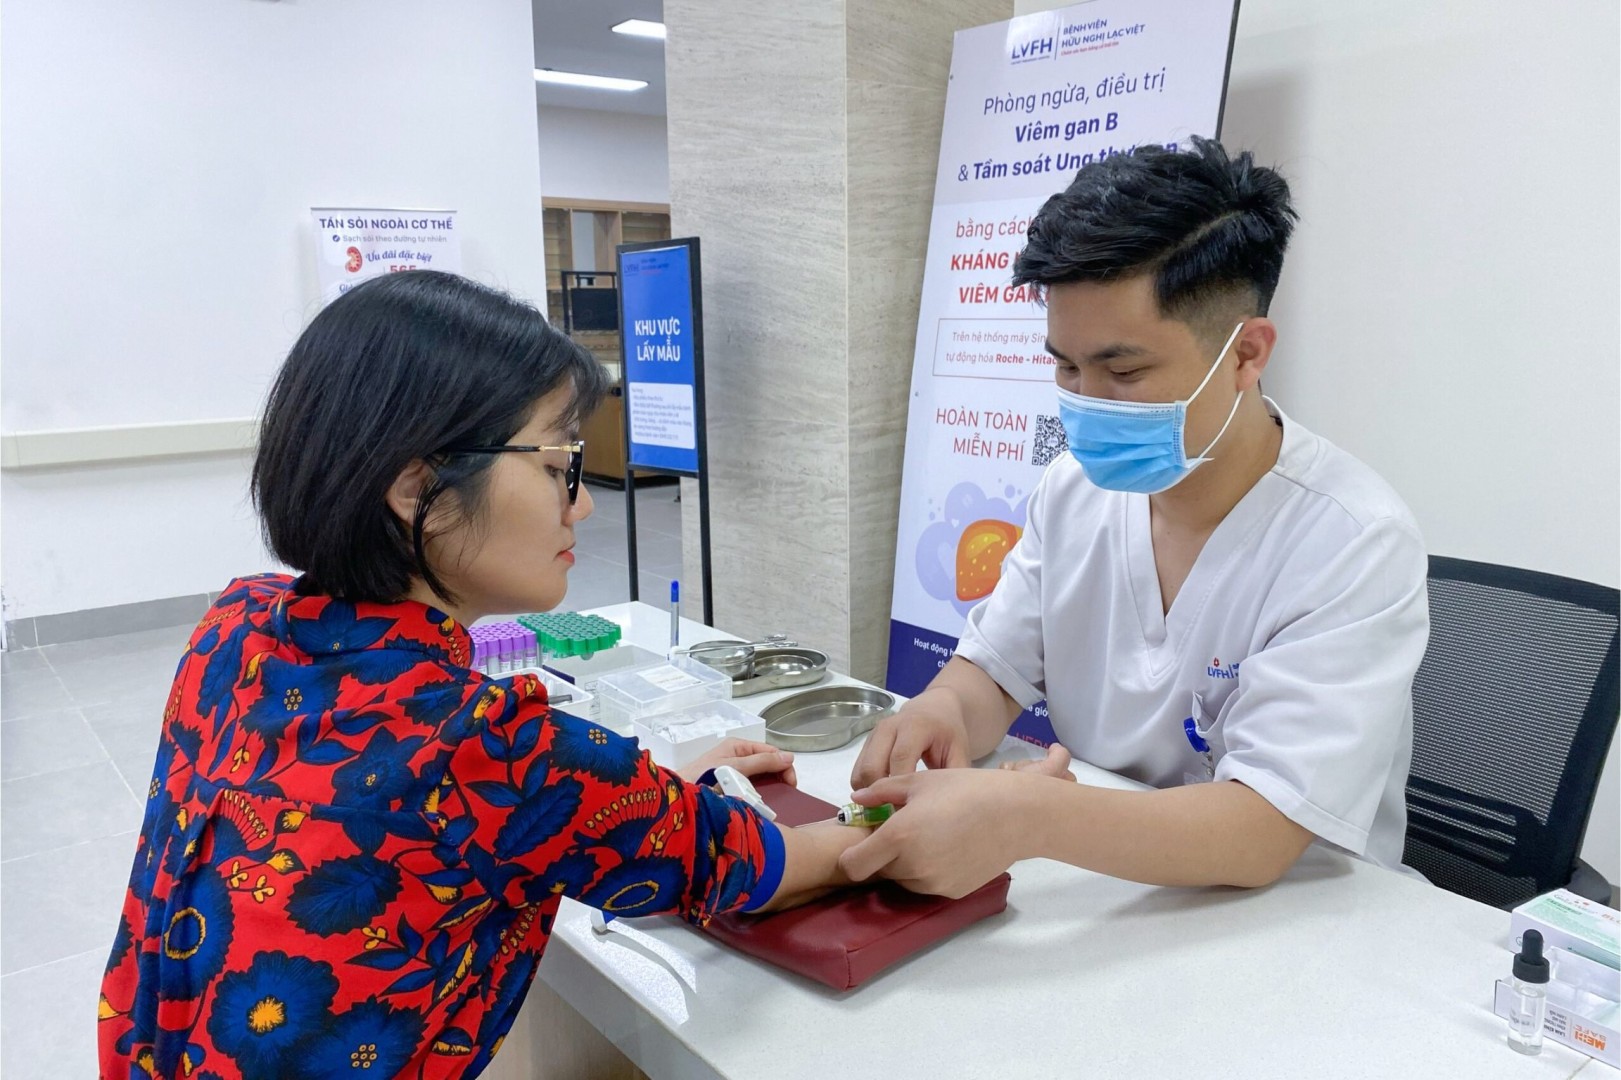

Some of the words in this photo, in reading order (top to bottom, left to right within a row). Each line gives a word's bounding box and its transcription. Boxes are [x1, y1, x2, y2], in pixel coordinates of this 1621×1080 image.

[1061, 34, 1081, 48] HỮU
[1082, 32, 1105, 46] NGHỊ
[1106, 29, 1125, 42] LẠC
[1125, 24, 1146, 36] VIỆT
[1063, 22, 1087, 36] BỆNH
[1088, 18, 1108, 32] VIỆN
[1012, 38, 1053, 60] LVFH
[984, 91, 1035, 116] Phòng
[1041, 84, 1090, 108] ngừa,
[1096, 75, 1137, 99] điều
[1143, 67, 1166, 92] trị
[1015, 121, 1060, 144] Viêm
[1064, 117, 1100, 140] gan
[1105, 112, 1118, 132] B
[958, 164, 968, 182] &
[974, 156, 1008, 180] Tầm
[1012, 154, 1051, 176] soát
[319, 218, 344, 229] TÁN
[347, 216, 368, 230] SỎI
[371, 216, 408, 230] NGOÀI
[412, 218, 428, 230] CƠ
[430, 216, 453, 230] THỂ
[956, 219, 994, 241] bằng
[375, 235, 392, 243] theo
[394, 235, 417, 244] đường
[382, 250, 396, 260] đãi
[398, 250, 415, 262] đặc
[950, 249, 1009, 271] KHÁNG
[959, 282, 999, 304] VIÊM
[634, 320, 656, 336] KHU
[658, 316, 680, 341] VỰC
[952, 331, 970, 343] Trên
[972, 332, 982, 344] hệ
[984, 330, 1008, 345] thống
[1010, 332, 1029, 344] máy
[1031, 333, 1046, 343] Sin
[636, 341, 656, 362] LẤY
[657, 336, 681, 362] MẪU
[946, 352, 954, 364] tự
[956, 351, 976, 365] động
[978, 352, 994, 364] hóa
[996, 352, 1024, 364] Roche
[1032, 354, 1056, 365] Hitac
[936, 406, 979, 428] HOÀN
[984, 409, 1028, 432] TOÀN
[953, 432, 992, 457] MIỄN
[996, 440, 1026, 462] PHÍ
[914, 638, 930, 650] Hoạt
[930, 643, 948, 657] động
[1208, 666, 1230, 679] LVFH
